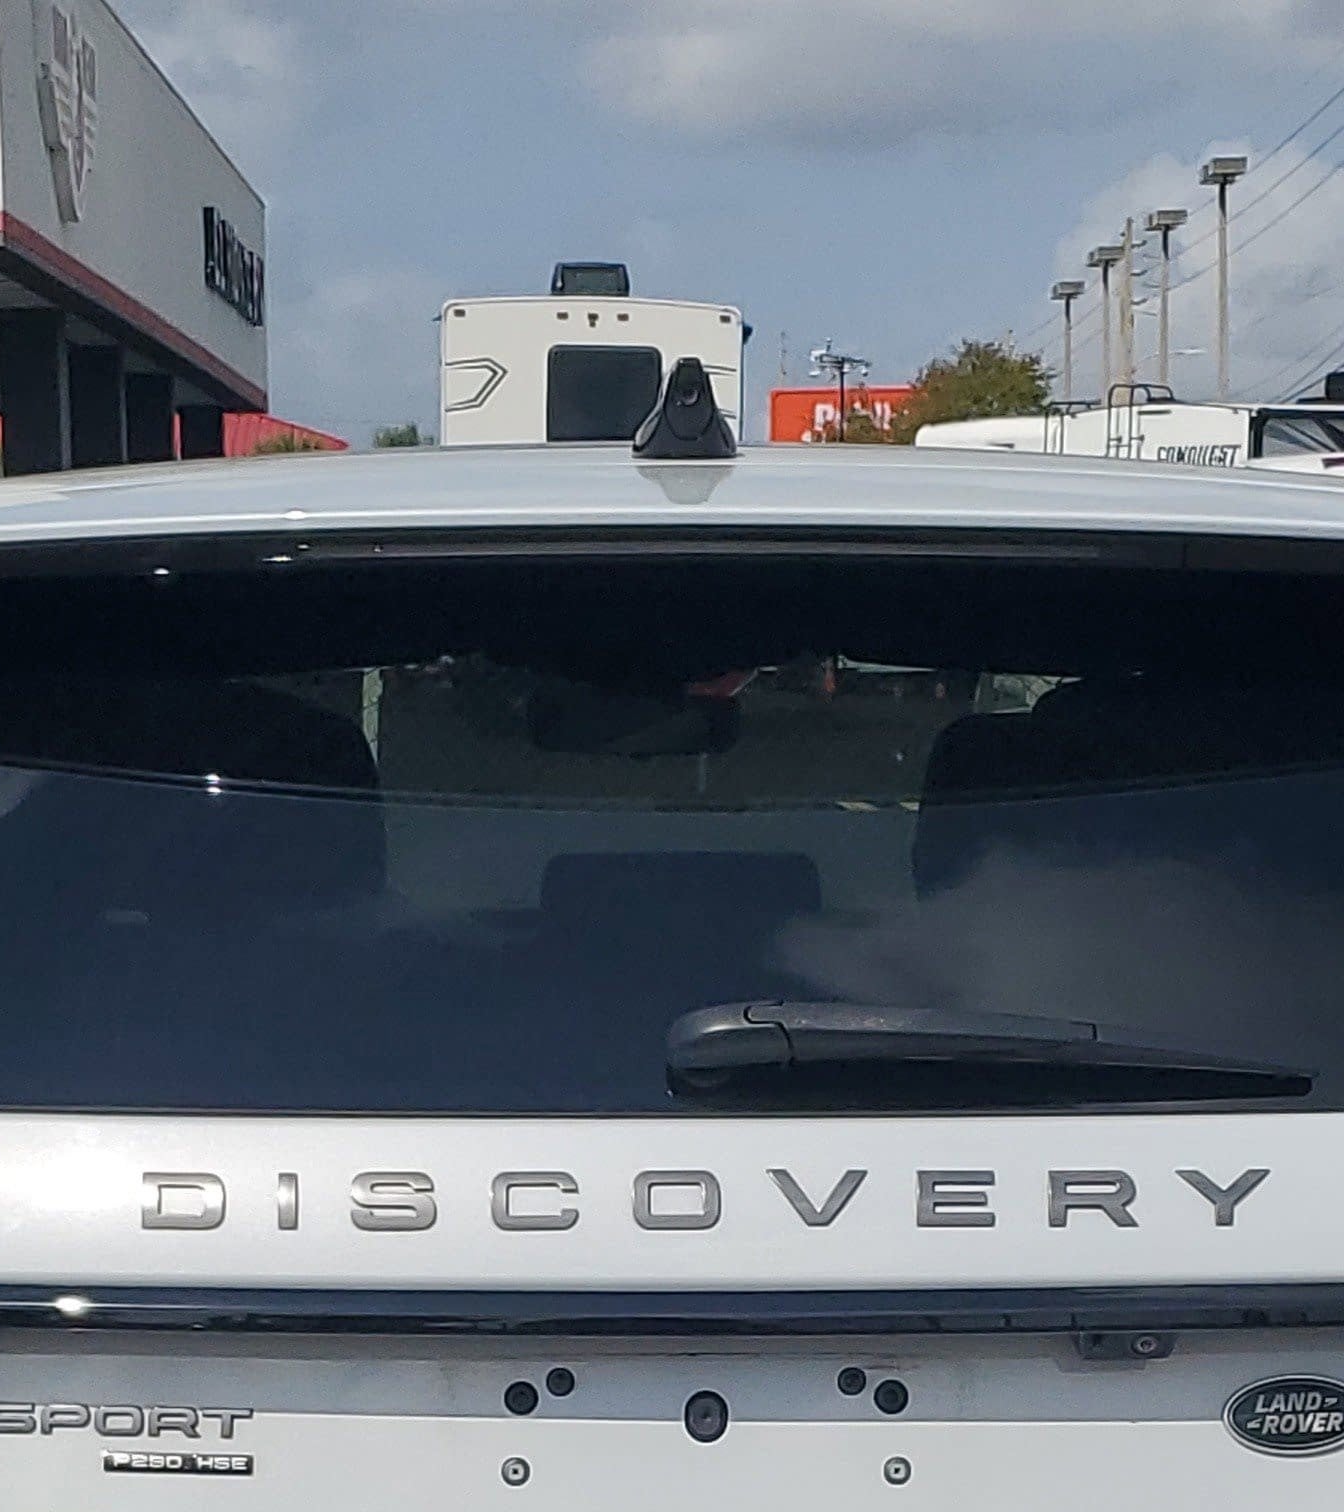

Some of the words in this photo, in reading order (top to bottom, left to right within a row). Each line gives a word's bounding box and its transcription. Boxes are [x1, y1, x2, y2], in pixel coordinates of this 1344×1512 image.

[1157, 444, 1242, 467] CONQUEST
[141, 1169, 1271, 1232] DISCOVERY
[1254, 1391, 1322, 1413] LAND
[1262, 1412, 1344, 1435] ROVER
[196, 1456, 249, 1471] HSE
